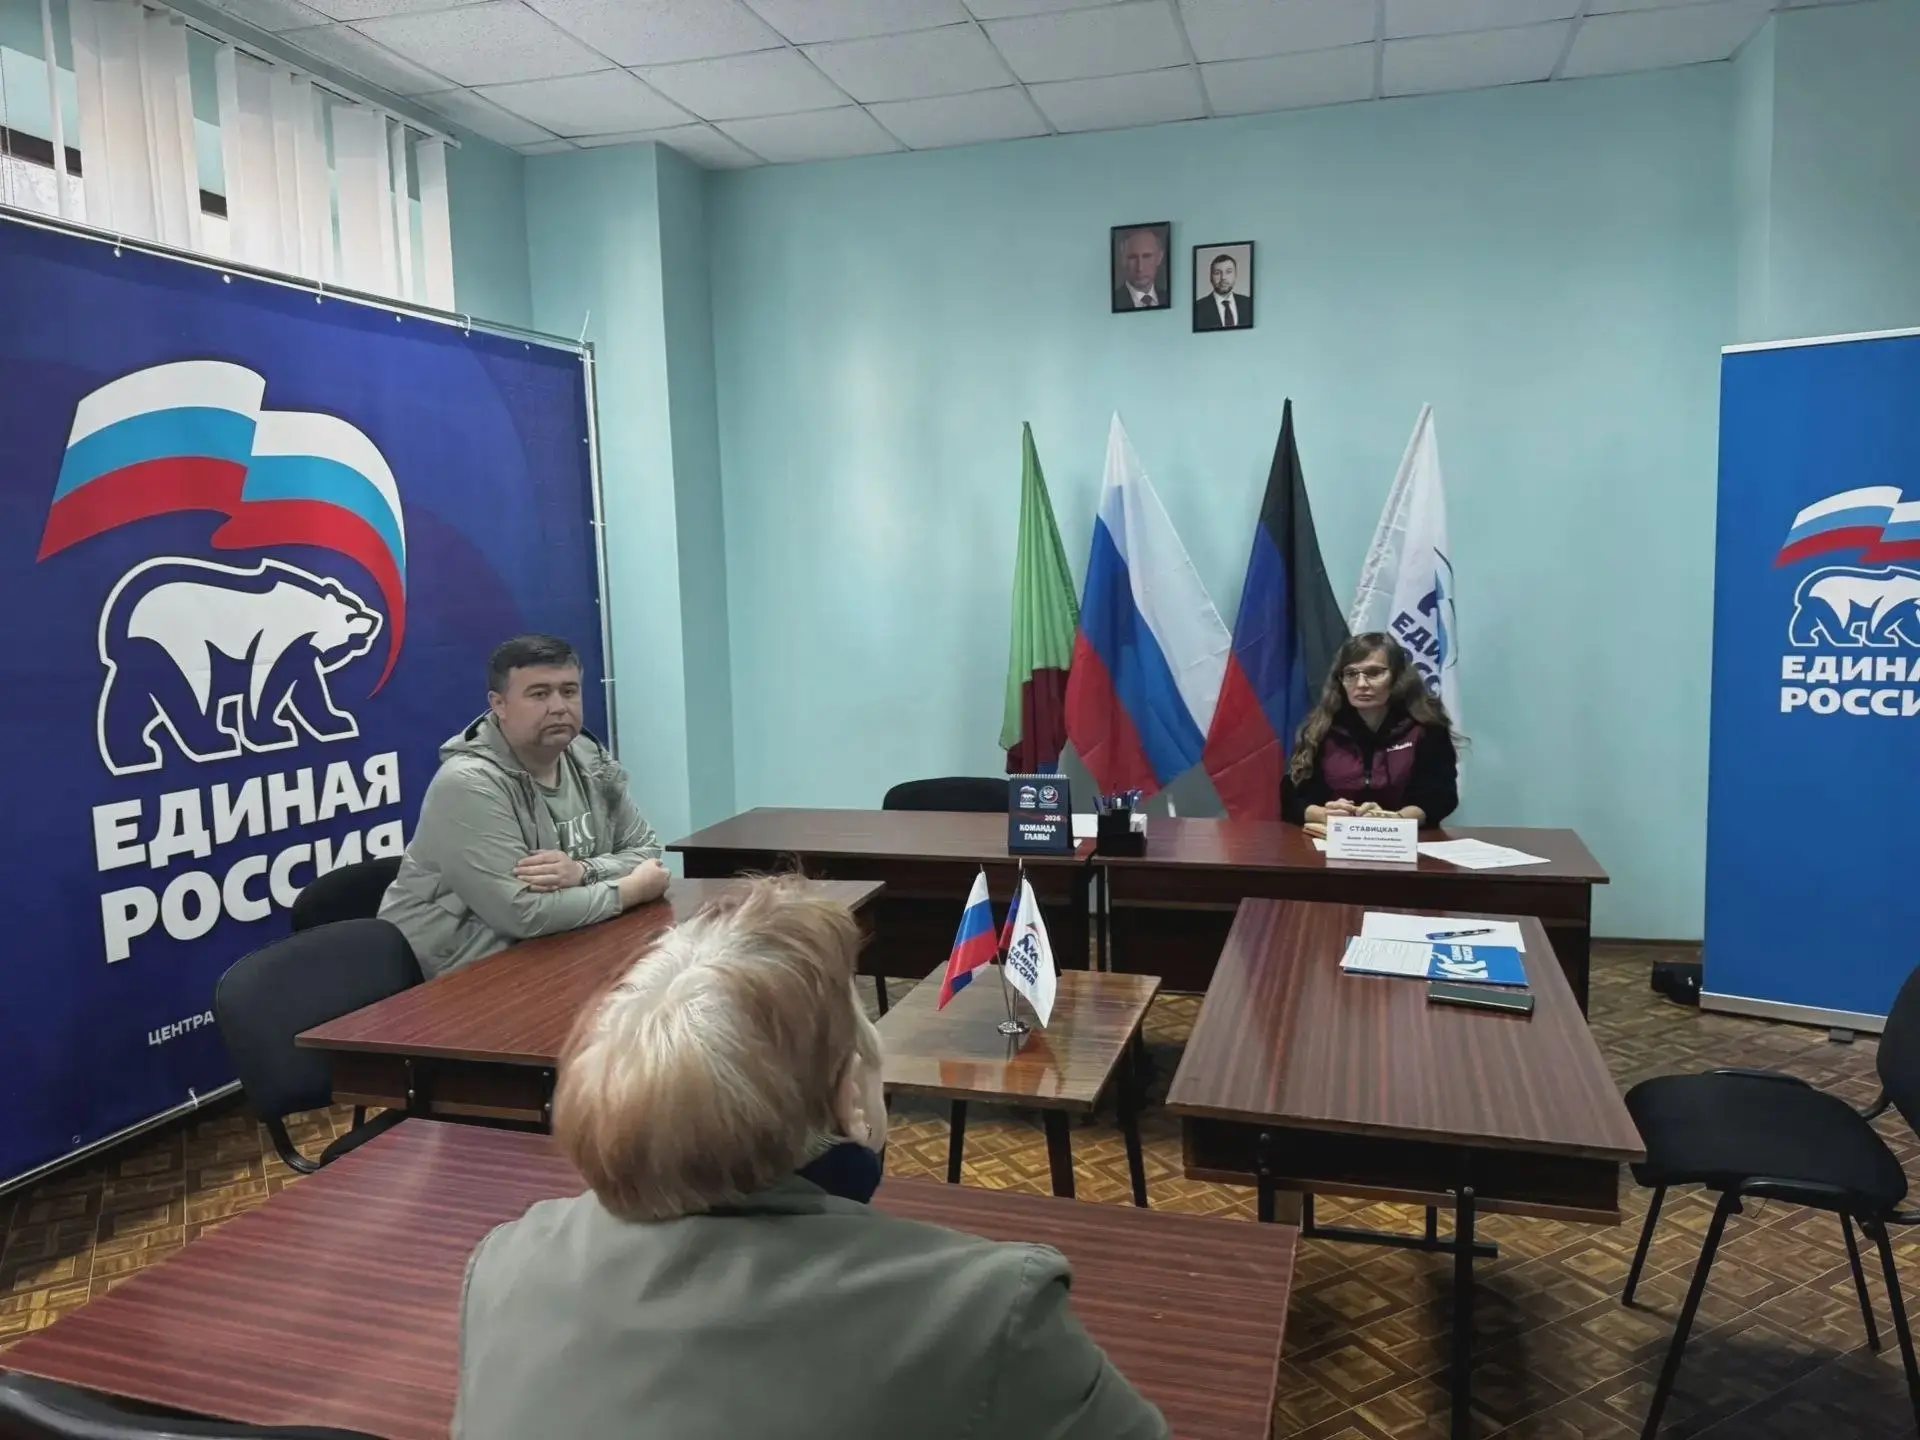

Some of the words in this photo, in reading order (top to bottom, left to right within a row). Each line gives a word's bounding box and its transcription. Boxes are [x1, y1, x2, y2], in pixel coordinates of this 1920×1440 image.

[92, 751, 400, 871] ЕДИНАЯ
[1019, 823, 1056, 833] КОМАНДА
[1024, 833, 1050, 841] ГЛАВЫ
[1349, 825, 1399, 833] СТАВИЦКАЯ
[1011, 946, 1039, 980] ЕДИНАЯ
[147, 1009, 215, 1046] ЦЕНТРА
